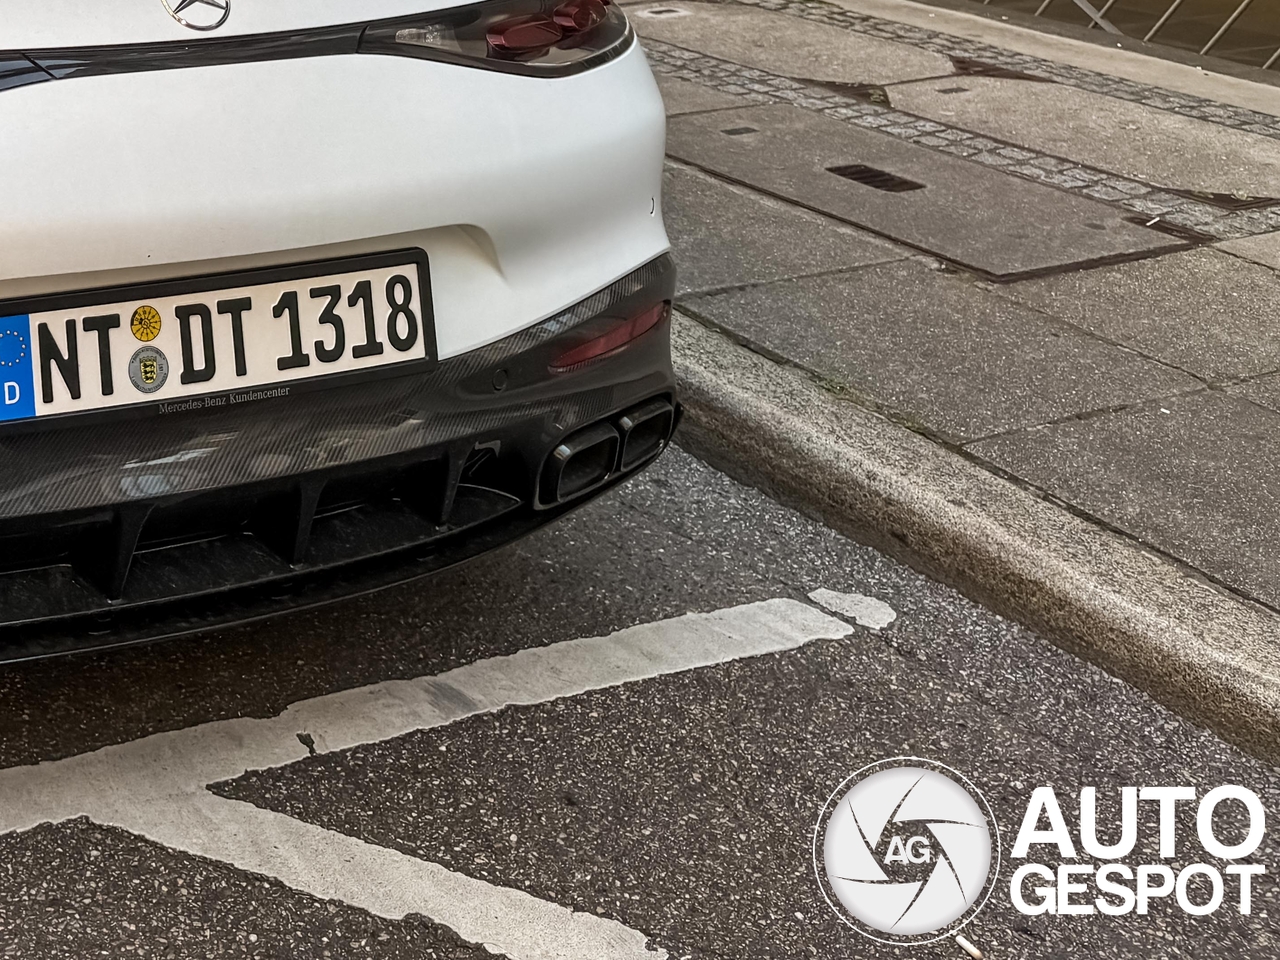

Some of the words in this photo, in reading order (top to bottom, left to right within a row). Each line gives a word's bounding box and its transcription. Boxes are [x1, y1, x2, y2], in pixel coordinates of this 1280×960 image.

[37, 313, 122, 404] NT
[174, 296, 253, 386] DT
[272, 274, 419, 372] 1318
[4, 381, 20, 406] D
[158, 396, 227, 415] Mercedes-Benz
[229, 387, 291, 405] Kundencenter
